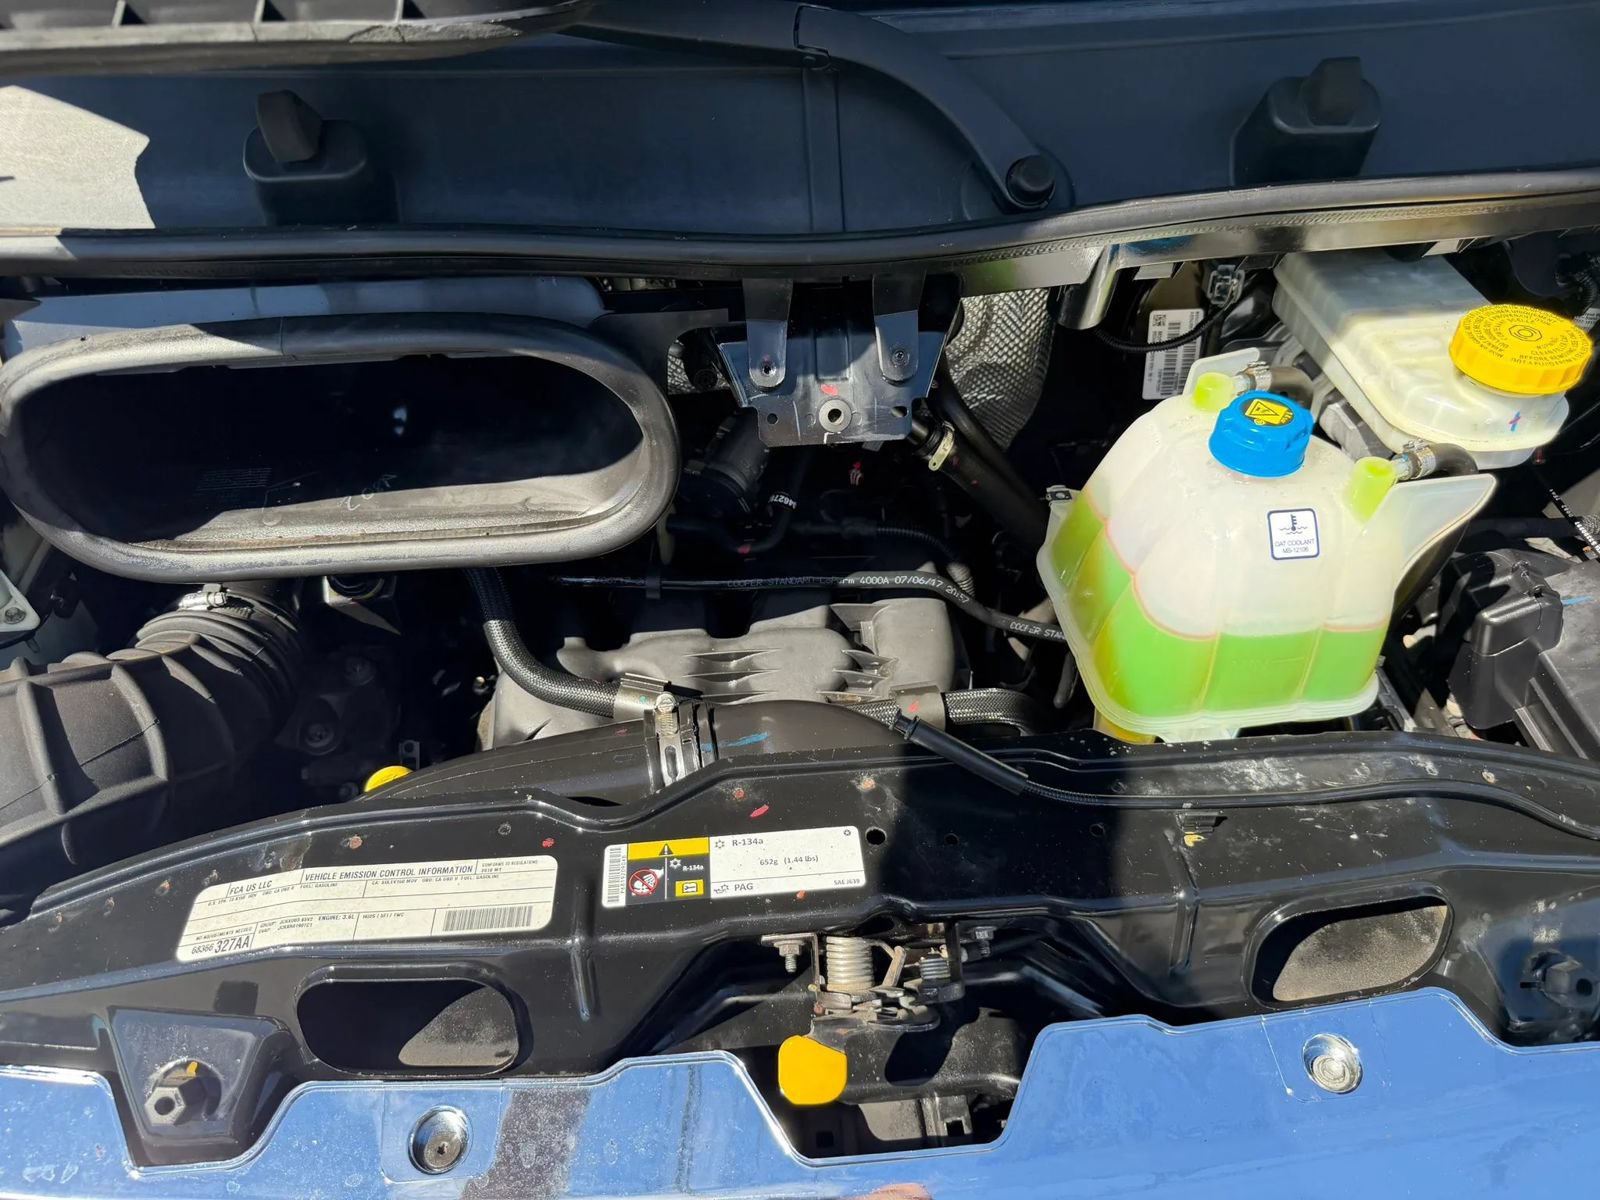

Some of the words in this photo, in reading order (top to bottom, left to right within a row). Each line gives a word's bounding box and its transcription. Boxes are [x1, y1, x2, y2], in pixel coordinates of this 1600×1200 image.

[1287, 538, 1315, 546] COOLANT
[859, 575, 890, 586] 4000A
[731, 838, 764, 847] R-134a
[759, 858, 778, 866] 652g
[783, 857, 804, 865] (1.44
[804, 855, 819, 863] lbs)
[305, 871, 337, 882] VEHICLE
[339, 870, 378, 880] EMISSION
[379, 868, 416, 878] CONTROL
[418, 865, 473, 875] INFORMATION
[682, 864, 705, 872] R-134a
[229, 885, 244, 896] FCA
[245, 883, 257, 892] US
[258, 880, 273, 890] LLC
[734, 883, 754, 892] PAG
[214, 935, 250, 954] 327AA
